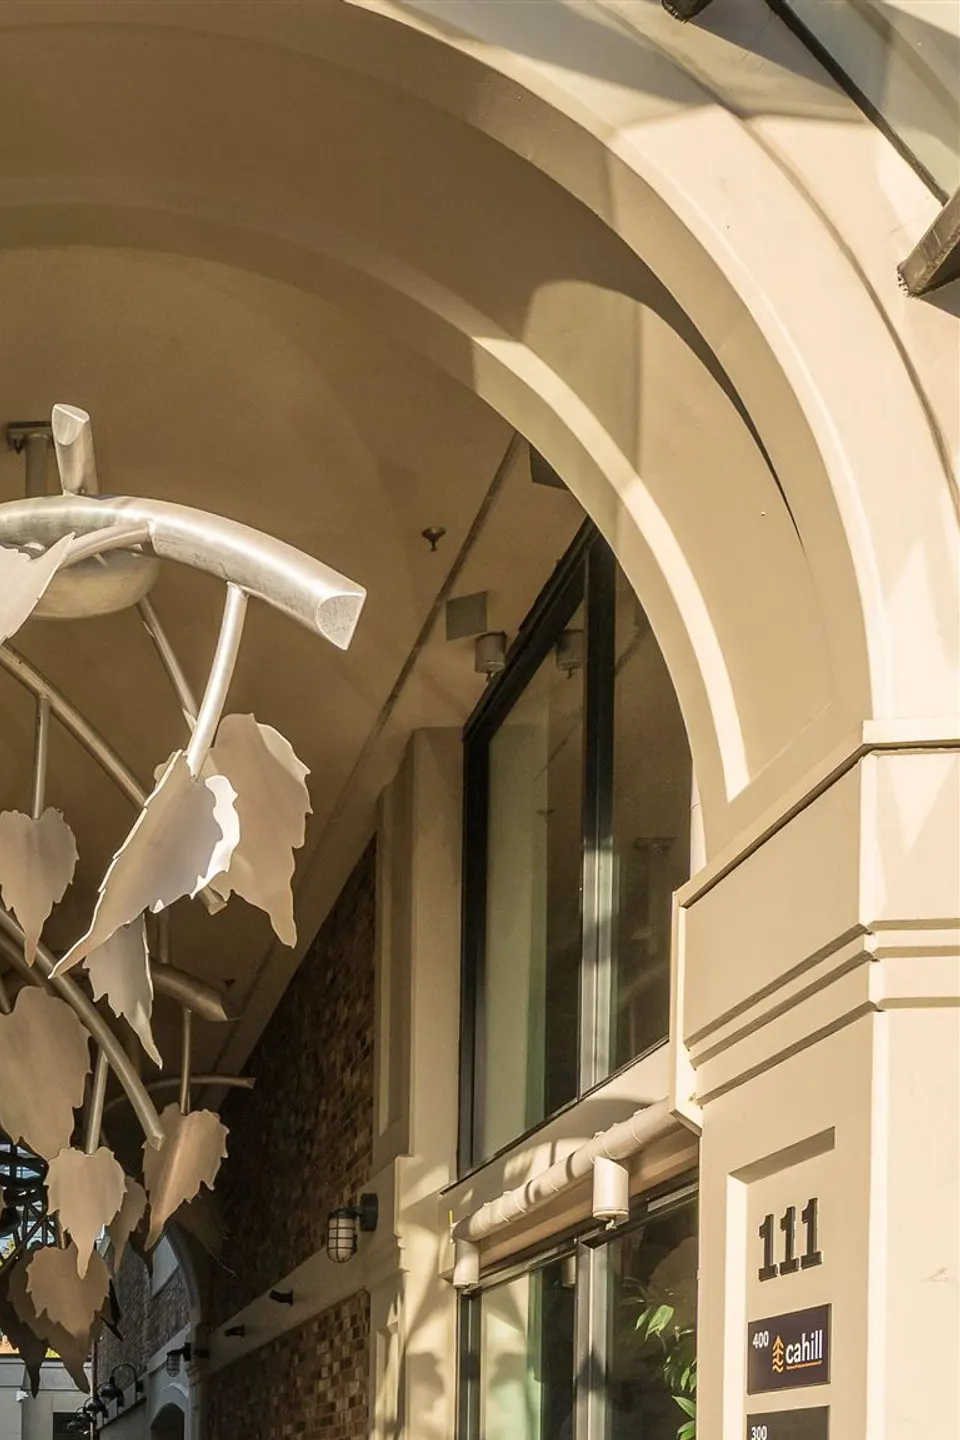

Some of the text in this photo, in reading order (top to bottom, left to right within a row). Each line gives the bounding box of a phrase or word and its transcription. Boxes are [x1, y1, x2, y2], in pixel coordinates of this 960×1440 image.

[758, 1198, 822, 1282] 111
[753, 1331, 769, 1349] 400
[786, 1330, 823, 1364] cahill
